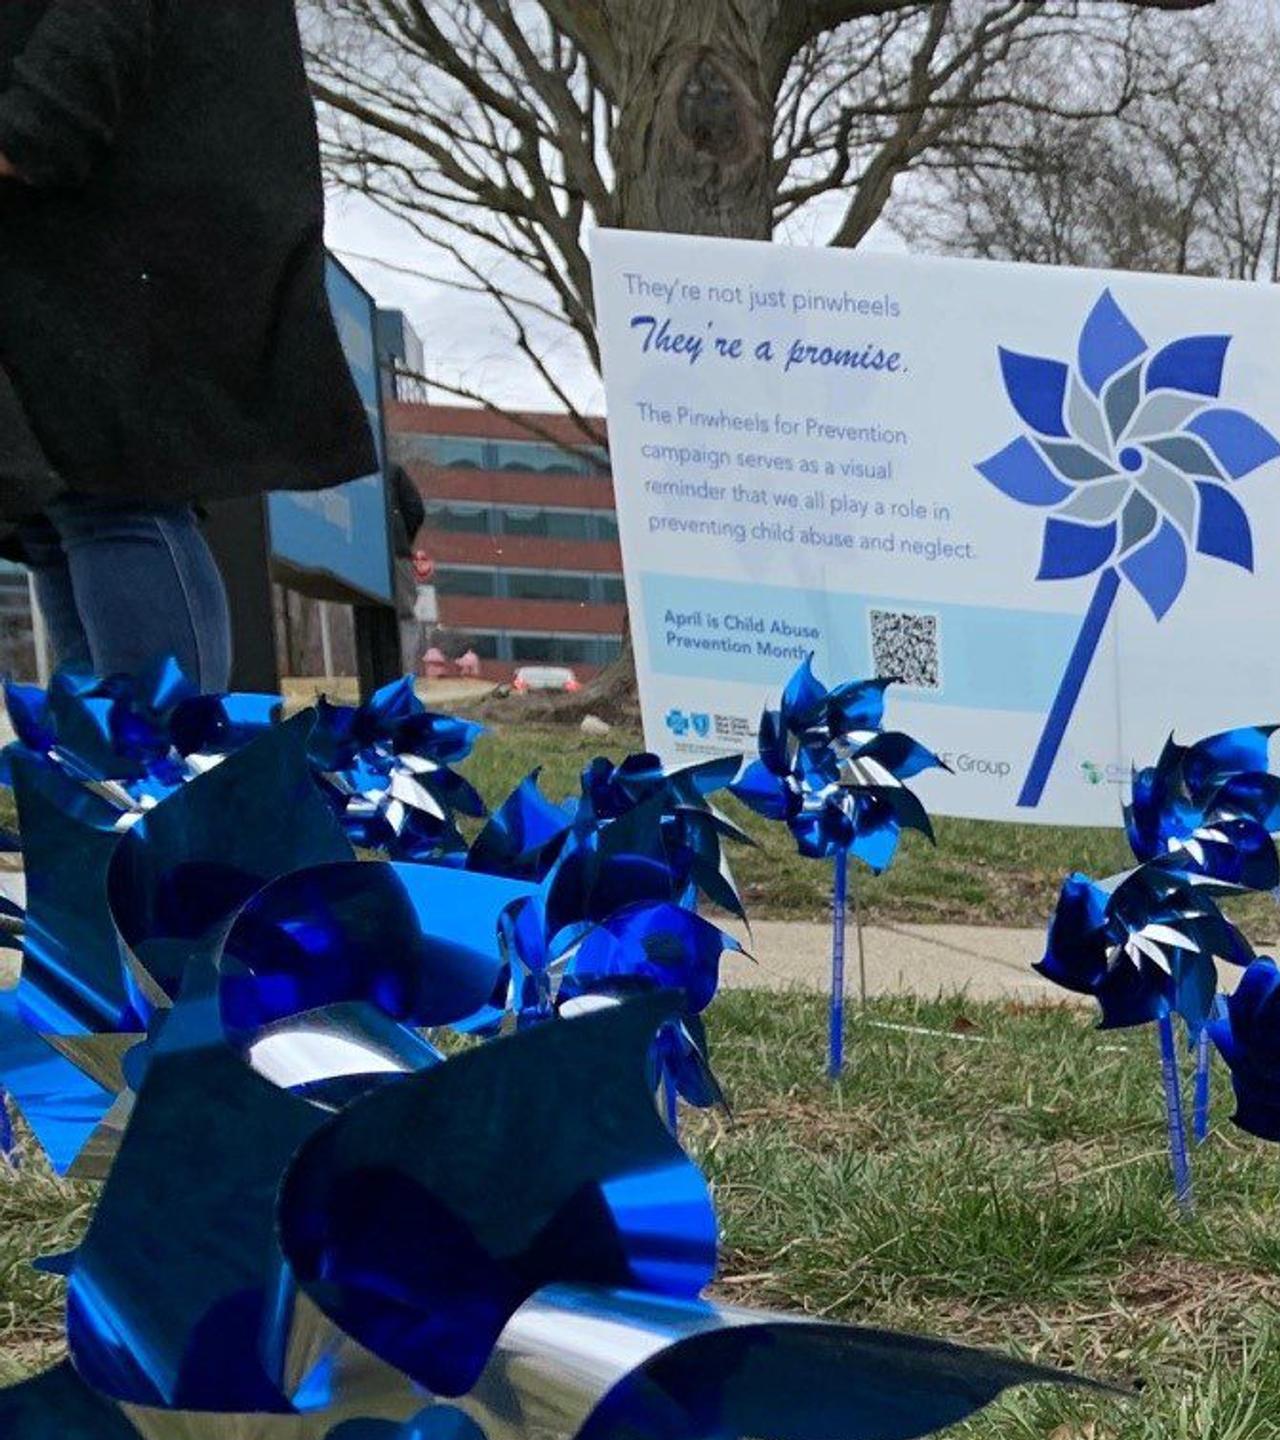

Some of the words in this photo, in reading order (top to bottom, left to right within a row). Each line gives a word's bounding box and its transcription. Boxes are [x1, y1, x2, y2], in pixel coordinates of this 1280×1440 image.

[623, 273, 700, 304] They're
[707, 286, 743, 304] not
[749, 285, 785, 311] just
[792, 290, 901, 318] pinwheels
[630, 315, 742, 365] They're
[756, 340, 773, 361] a
[784, 338, 909, 373] promise.
[635, 402, 671, 424] The
[677, 405, 769, 433] Pinwheels
[775, 413, 799, 435] for
[806, 417, 907, 445] Prevention
[641, 443, 731, 470] campaign
[737, 451, 793, 471] serves
[800, 458, 818, 474] as
[825, 460, 835, 476] a
[841, 460, 892, 480] visual
[645, 480, 726, 500] reminder
[732, 483, 767, 506] that
[773, 493, 799, 508] we
[804, 491, 824, 510] all
[830, 494, 868, 518] play
[874, 501, 885, 515] a
[891, 498, 927, 519] role
[933, 505, 950, 521] in
[649, 516, 746, 543] preventing
[751, 521, 794, 543] child
[800, 526, 853, 548] abuse
[860, 533, 895, 552] and
[665, 609, 701, 629] April
[707, 614, 719, 629] is
[723, 615, 764, 634] Child
[770, 620, 820, 639] Abuse
[666, 631, 752, 654] Prevention
[757, 642, 806, 660] Month
[956, 752, 1011, 777] Group
